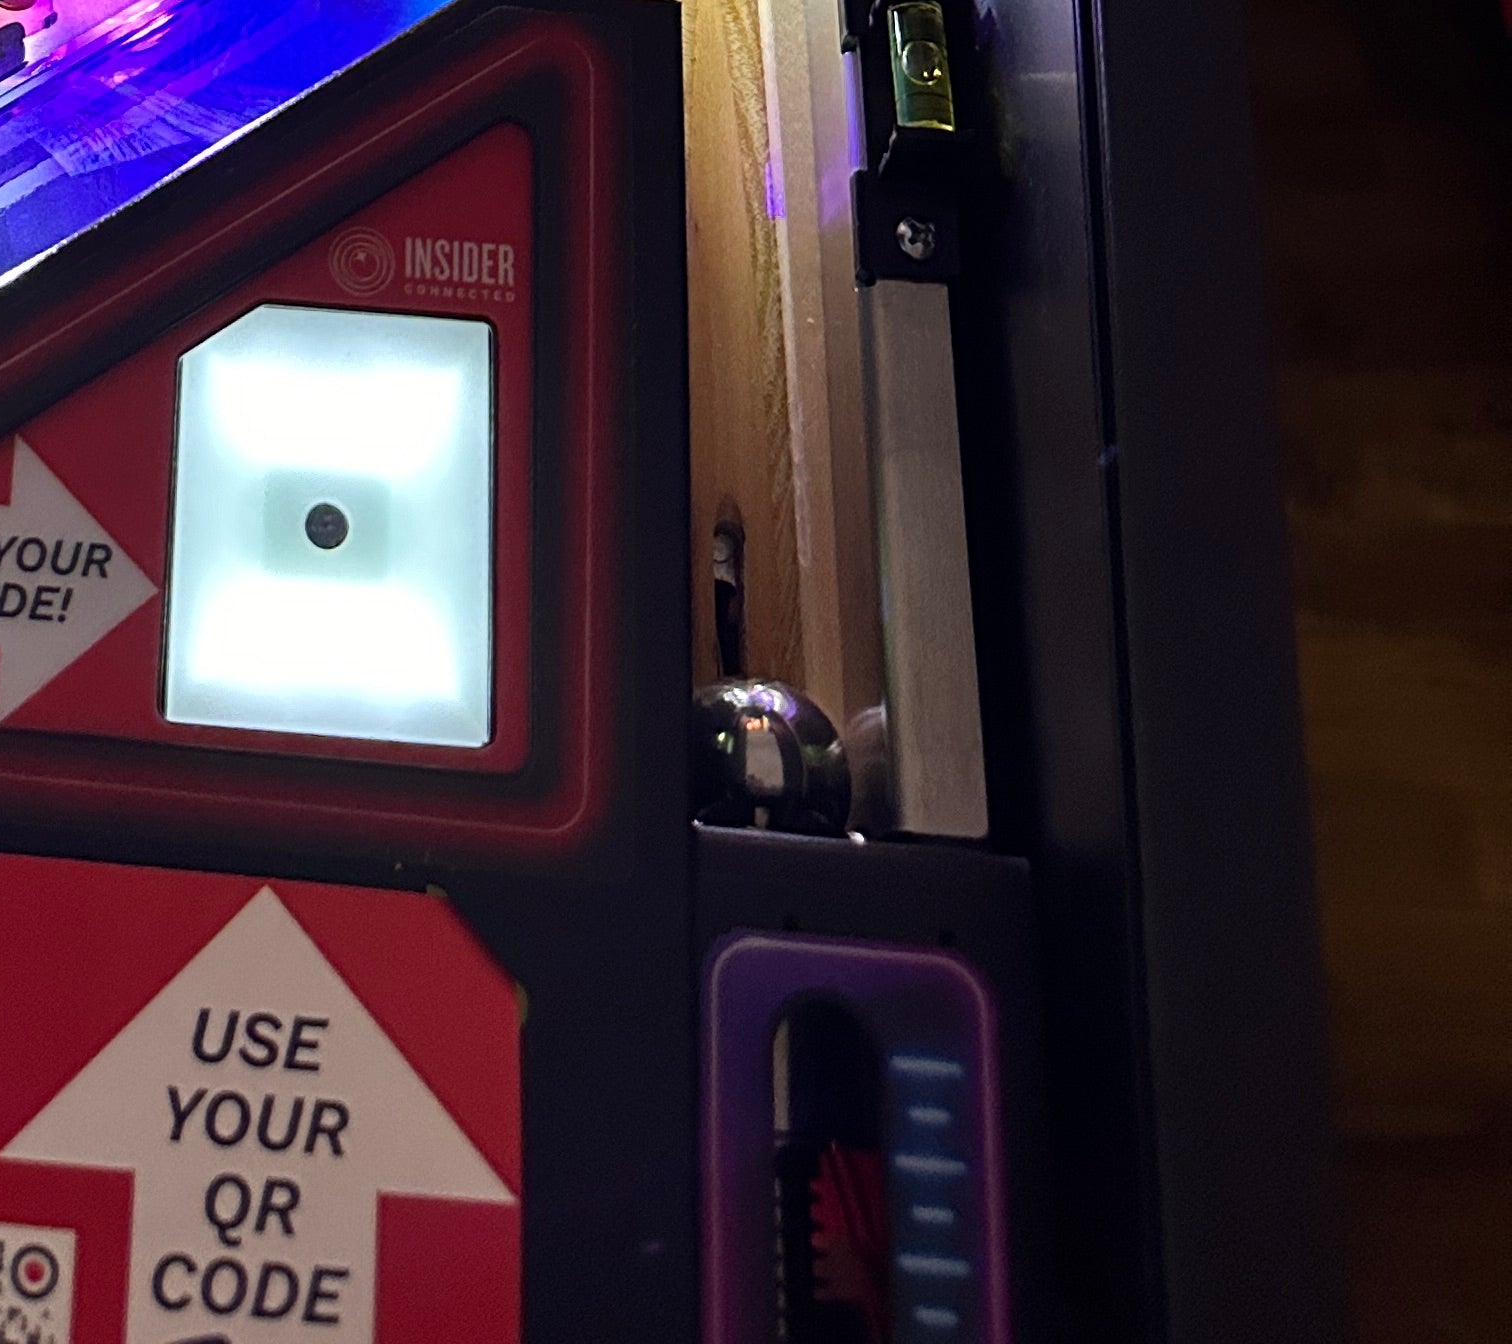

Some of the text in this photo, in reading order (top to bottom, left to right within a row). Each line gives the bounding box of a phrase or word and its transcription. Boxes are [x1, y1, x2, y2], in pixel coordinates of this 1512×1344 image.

[403, 236, 516, 287] INSIDER
[403, 282, 516, 303] CONNECTED
[192, 1006, 330, 1072] USE
[166, 1083, 351, 1158] YOUR
[203, 1171, 302, 1248] QR
[151, 1249, 351, 1326] CODE
